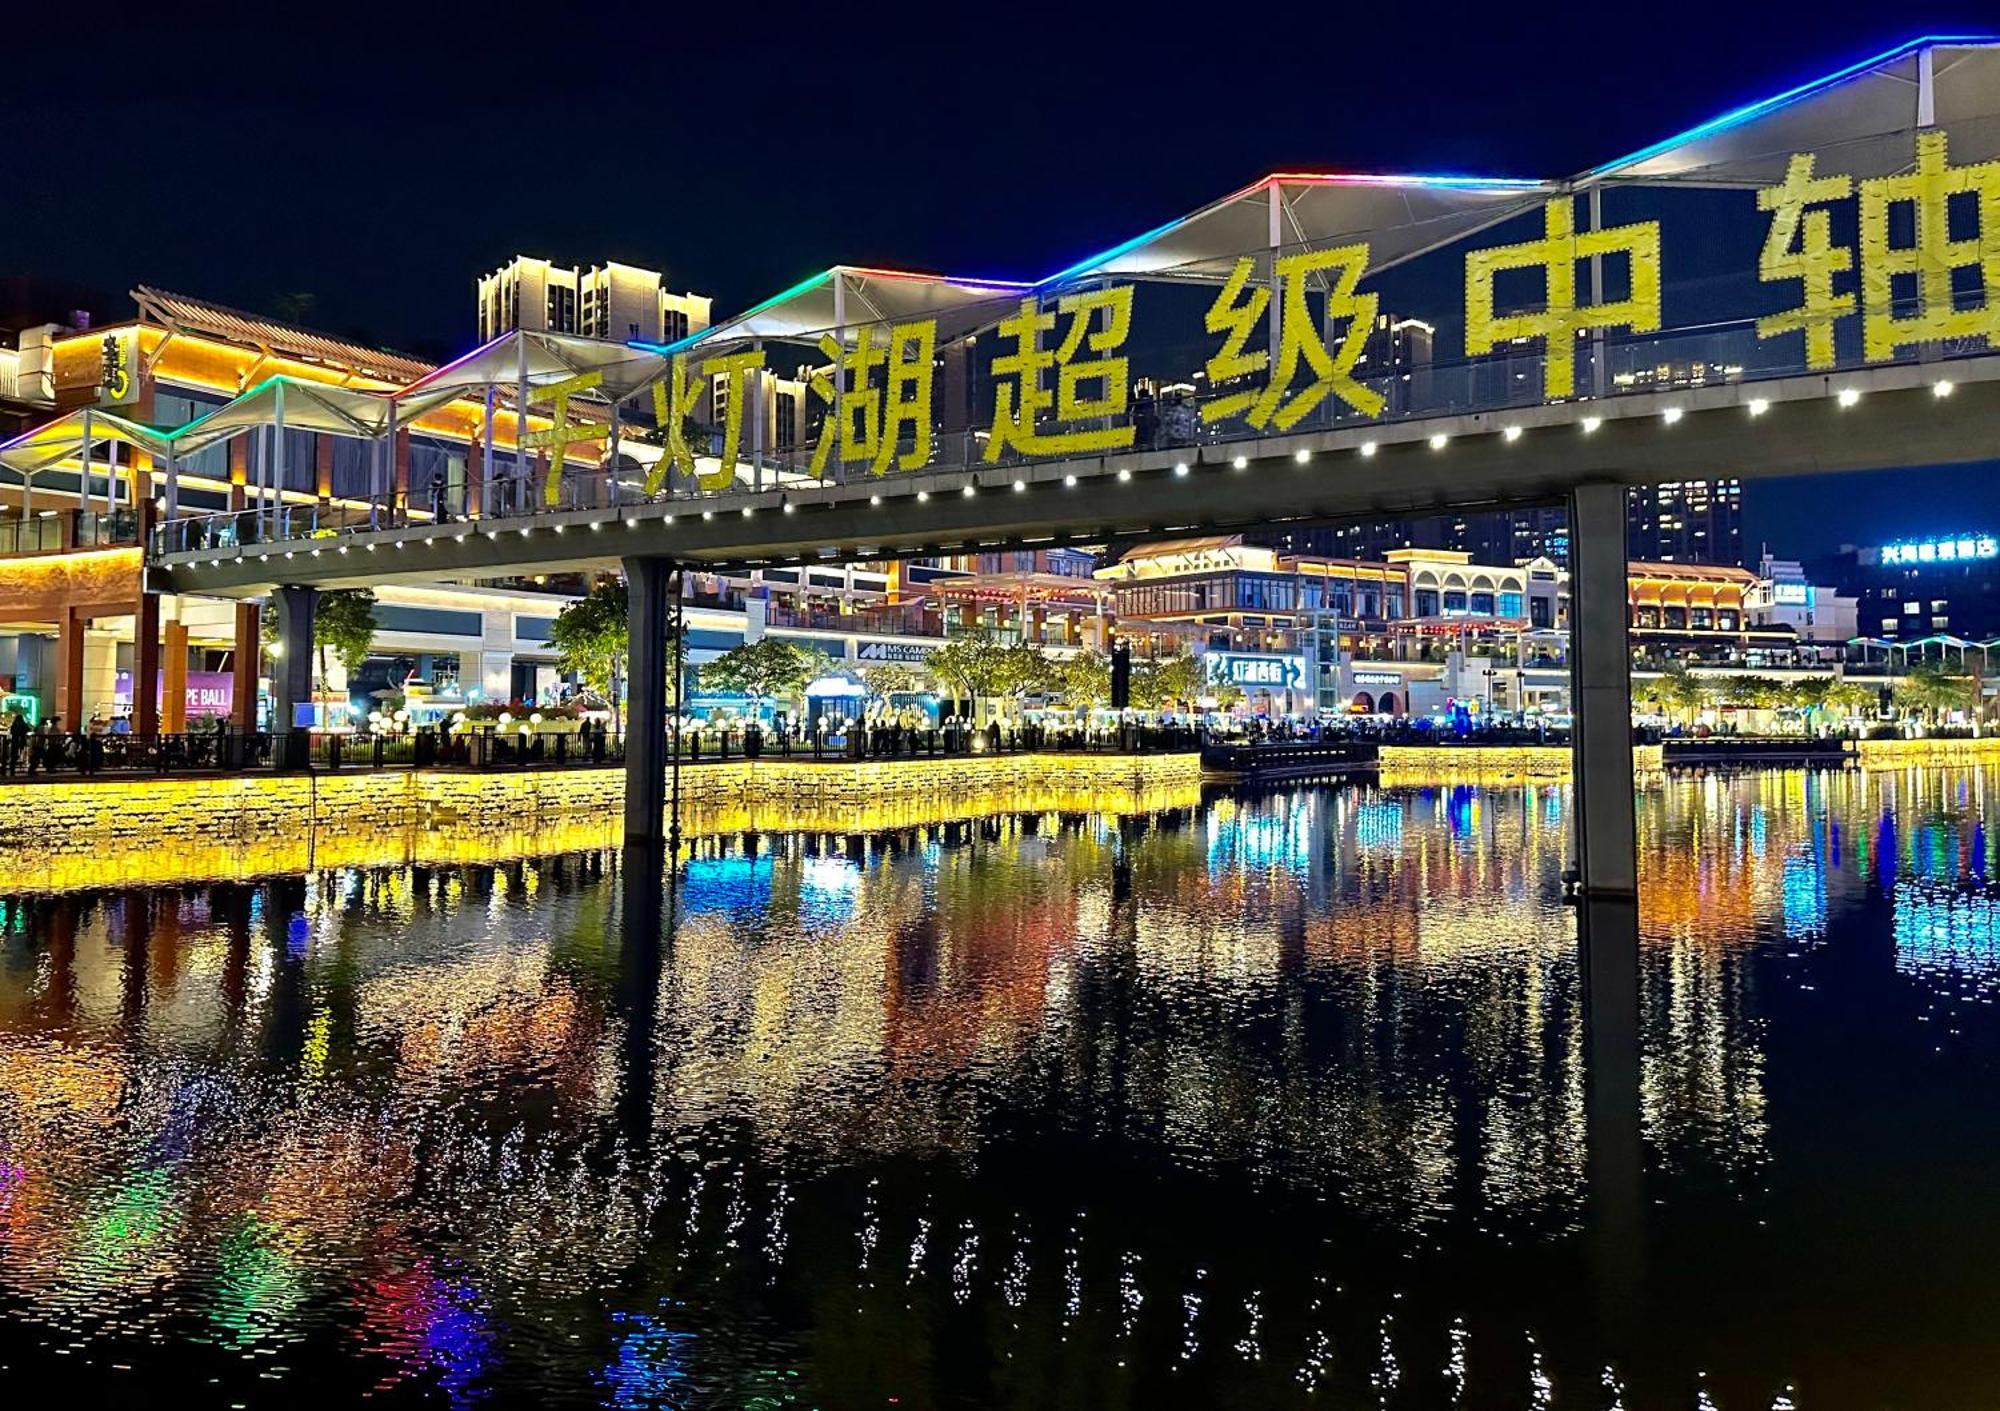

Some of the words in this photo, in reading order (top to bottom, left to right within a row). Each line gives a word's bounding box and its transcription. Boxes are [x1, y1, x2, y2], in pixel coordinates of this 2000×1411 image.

[517, 131, 2000, 506] 千灯湖超级中轴
[201, 689, 227, 706] BALL
